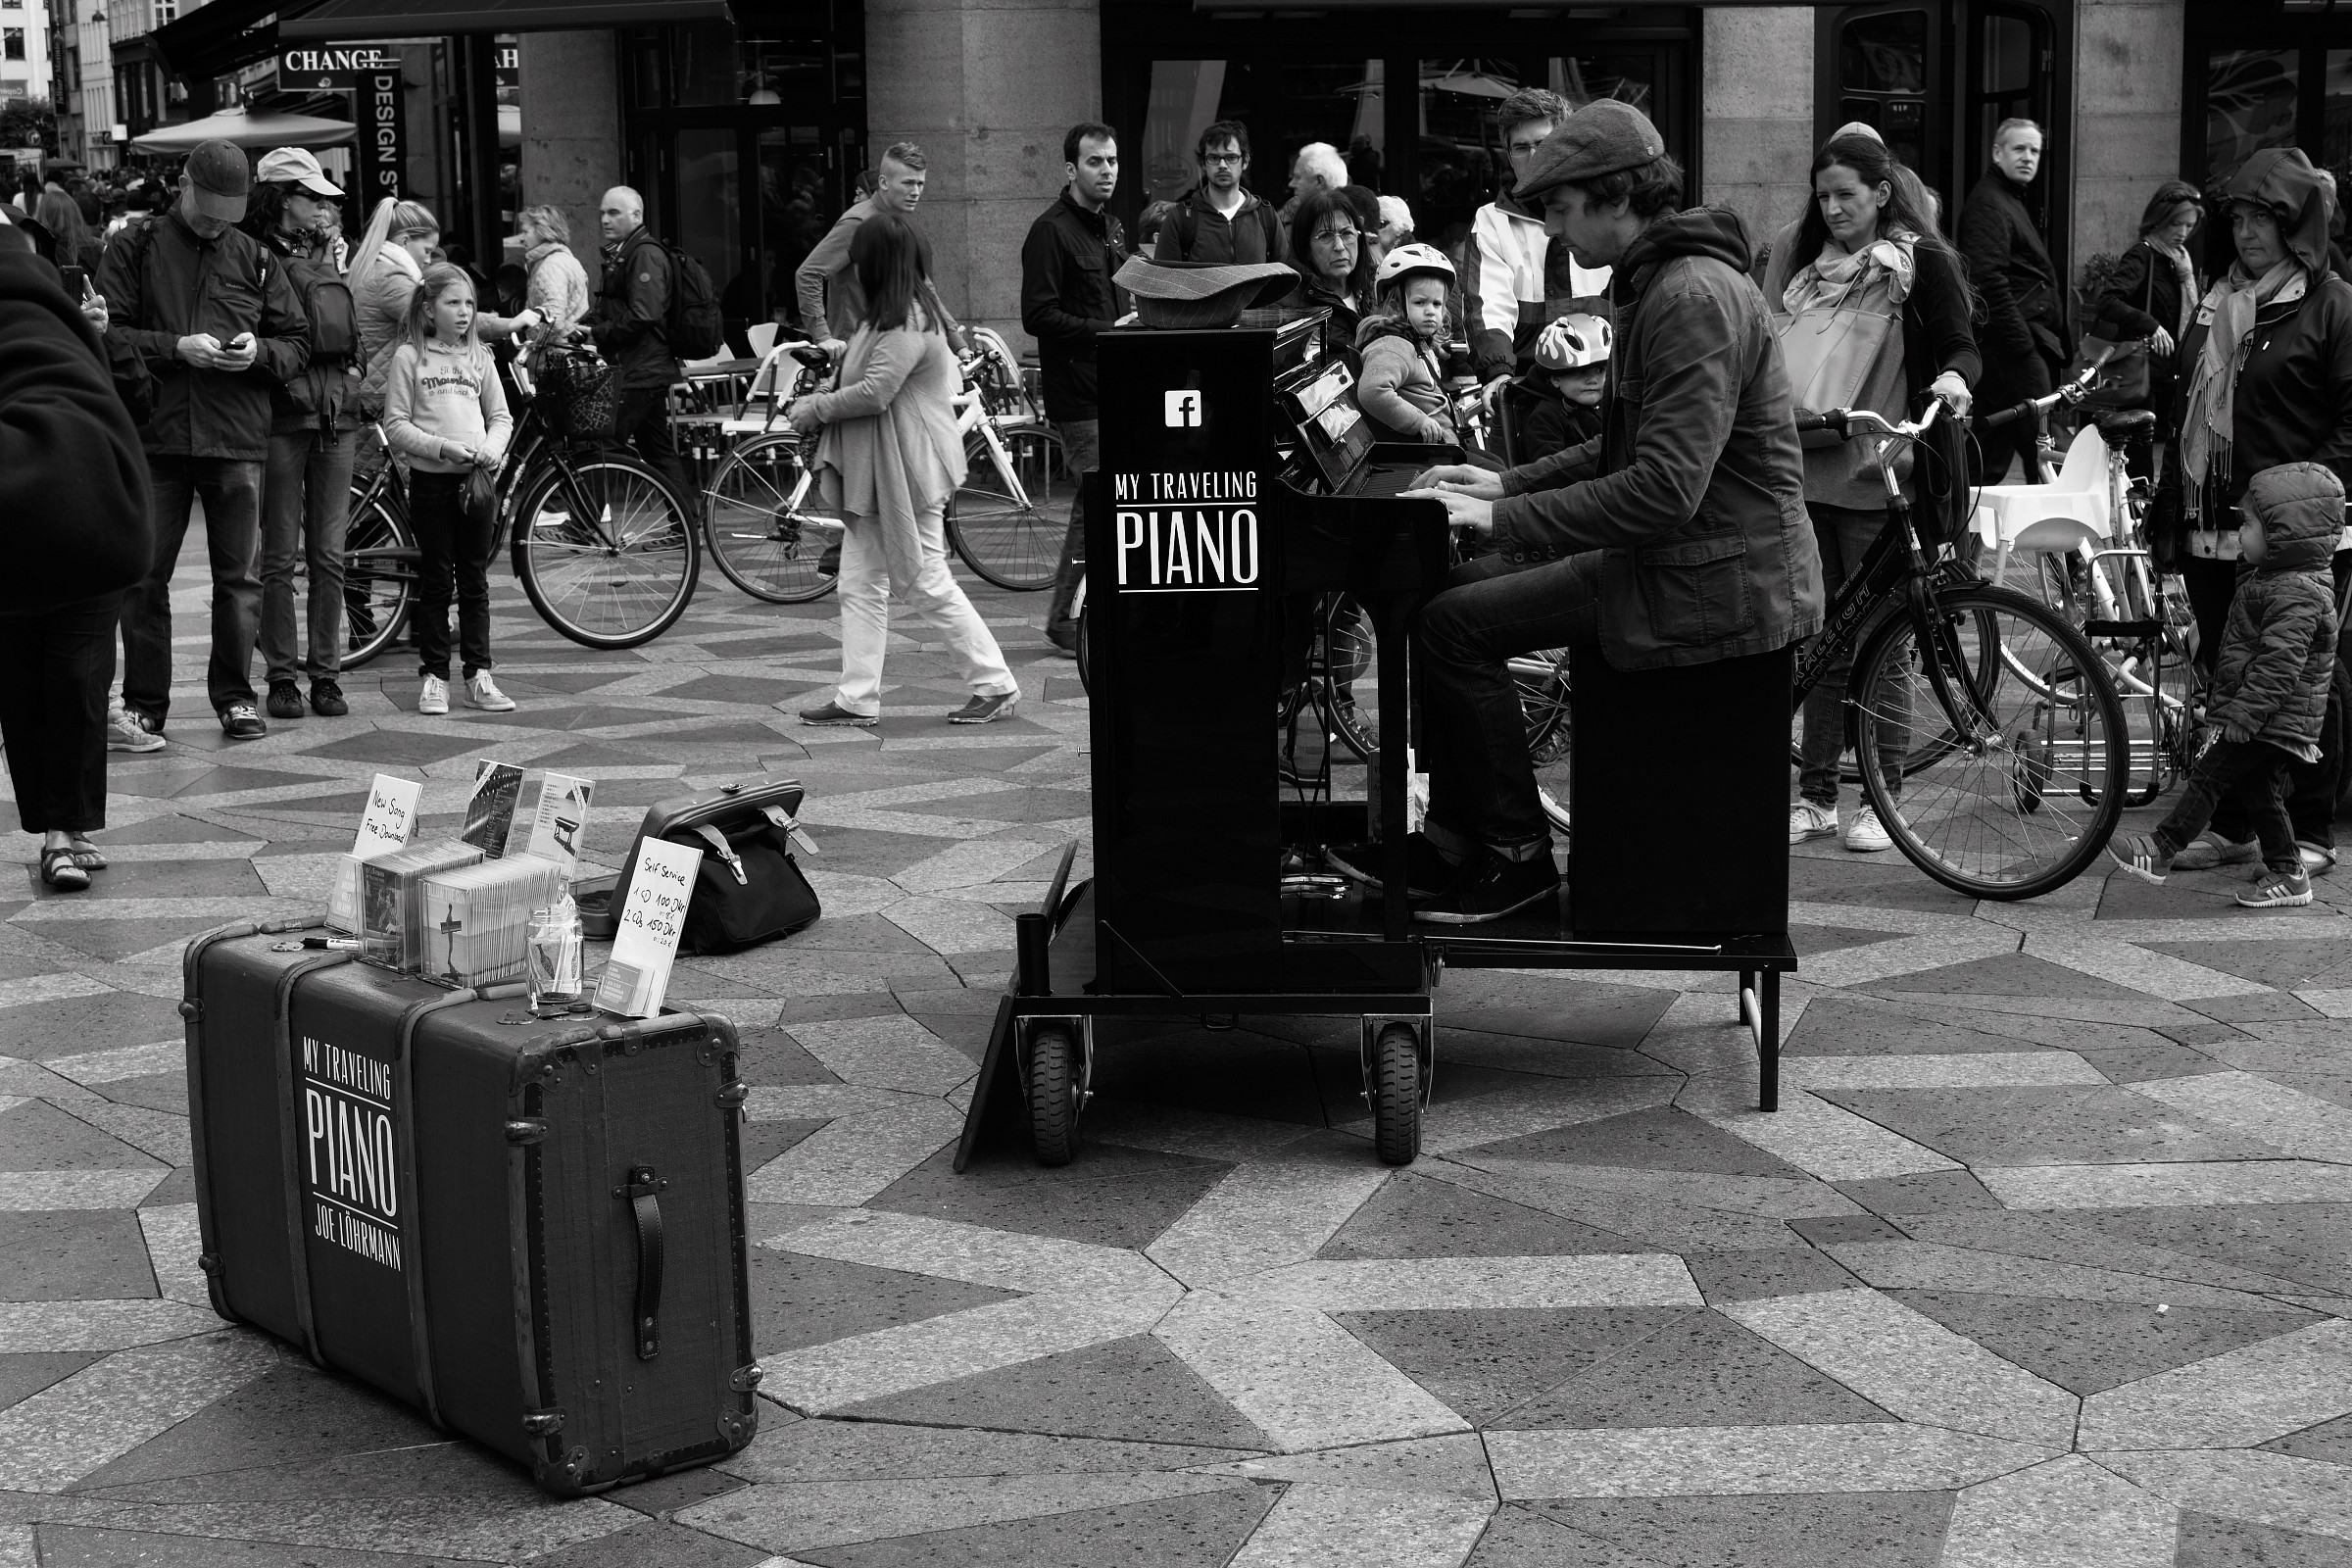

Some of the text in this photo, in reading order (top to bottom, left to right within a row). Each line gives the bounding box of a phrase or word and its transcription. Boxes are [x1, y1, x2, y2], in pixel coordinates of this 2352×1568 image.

[285, 49, 383, 72] CHANGE
[374, 74, 397, 163] DESIGN
[1115, 471, 1257, 500] MY TRAVELING
[1116, 510, 1258, 585] PIANO
[372, 790, 406, 830] New Song
[365, 818, 406, 844] Free Download
[644, 857, 686, 887] Self Service
[656, 894, 671, 907] 100
[623, 908, 631, 922] 2
[632, 910, 643, 928] CDs
[647, 918, 663, 932] 150
[303, 1036, 391, 1101] MY TRAVELING
[306, 1087, 397, 1217] PIANO
[315, 1202, 401, 1272] JOE LÖHRMANN
